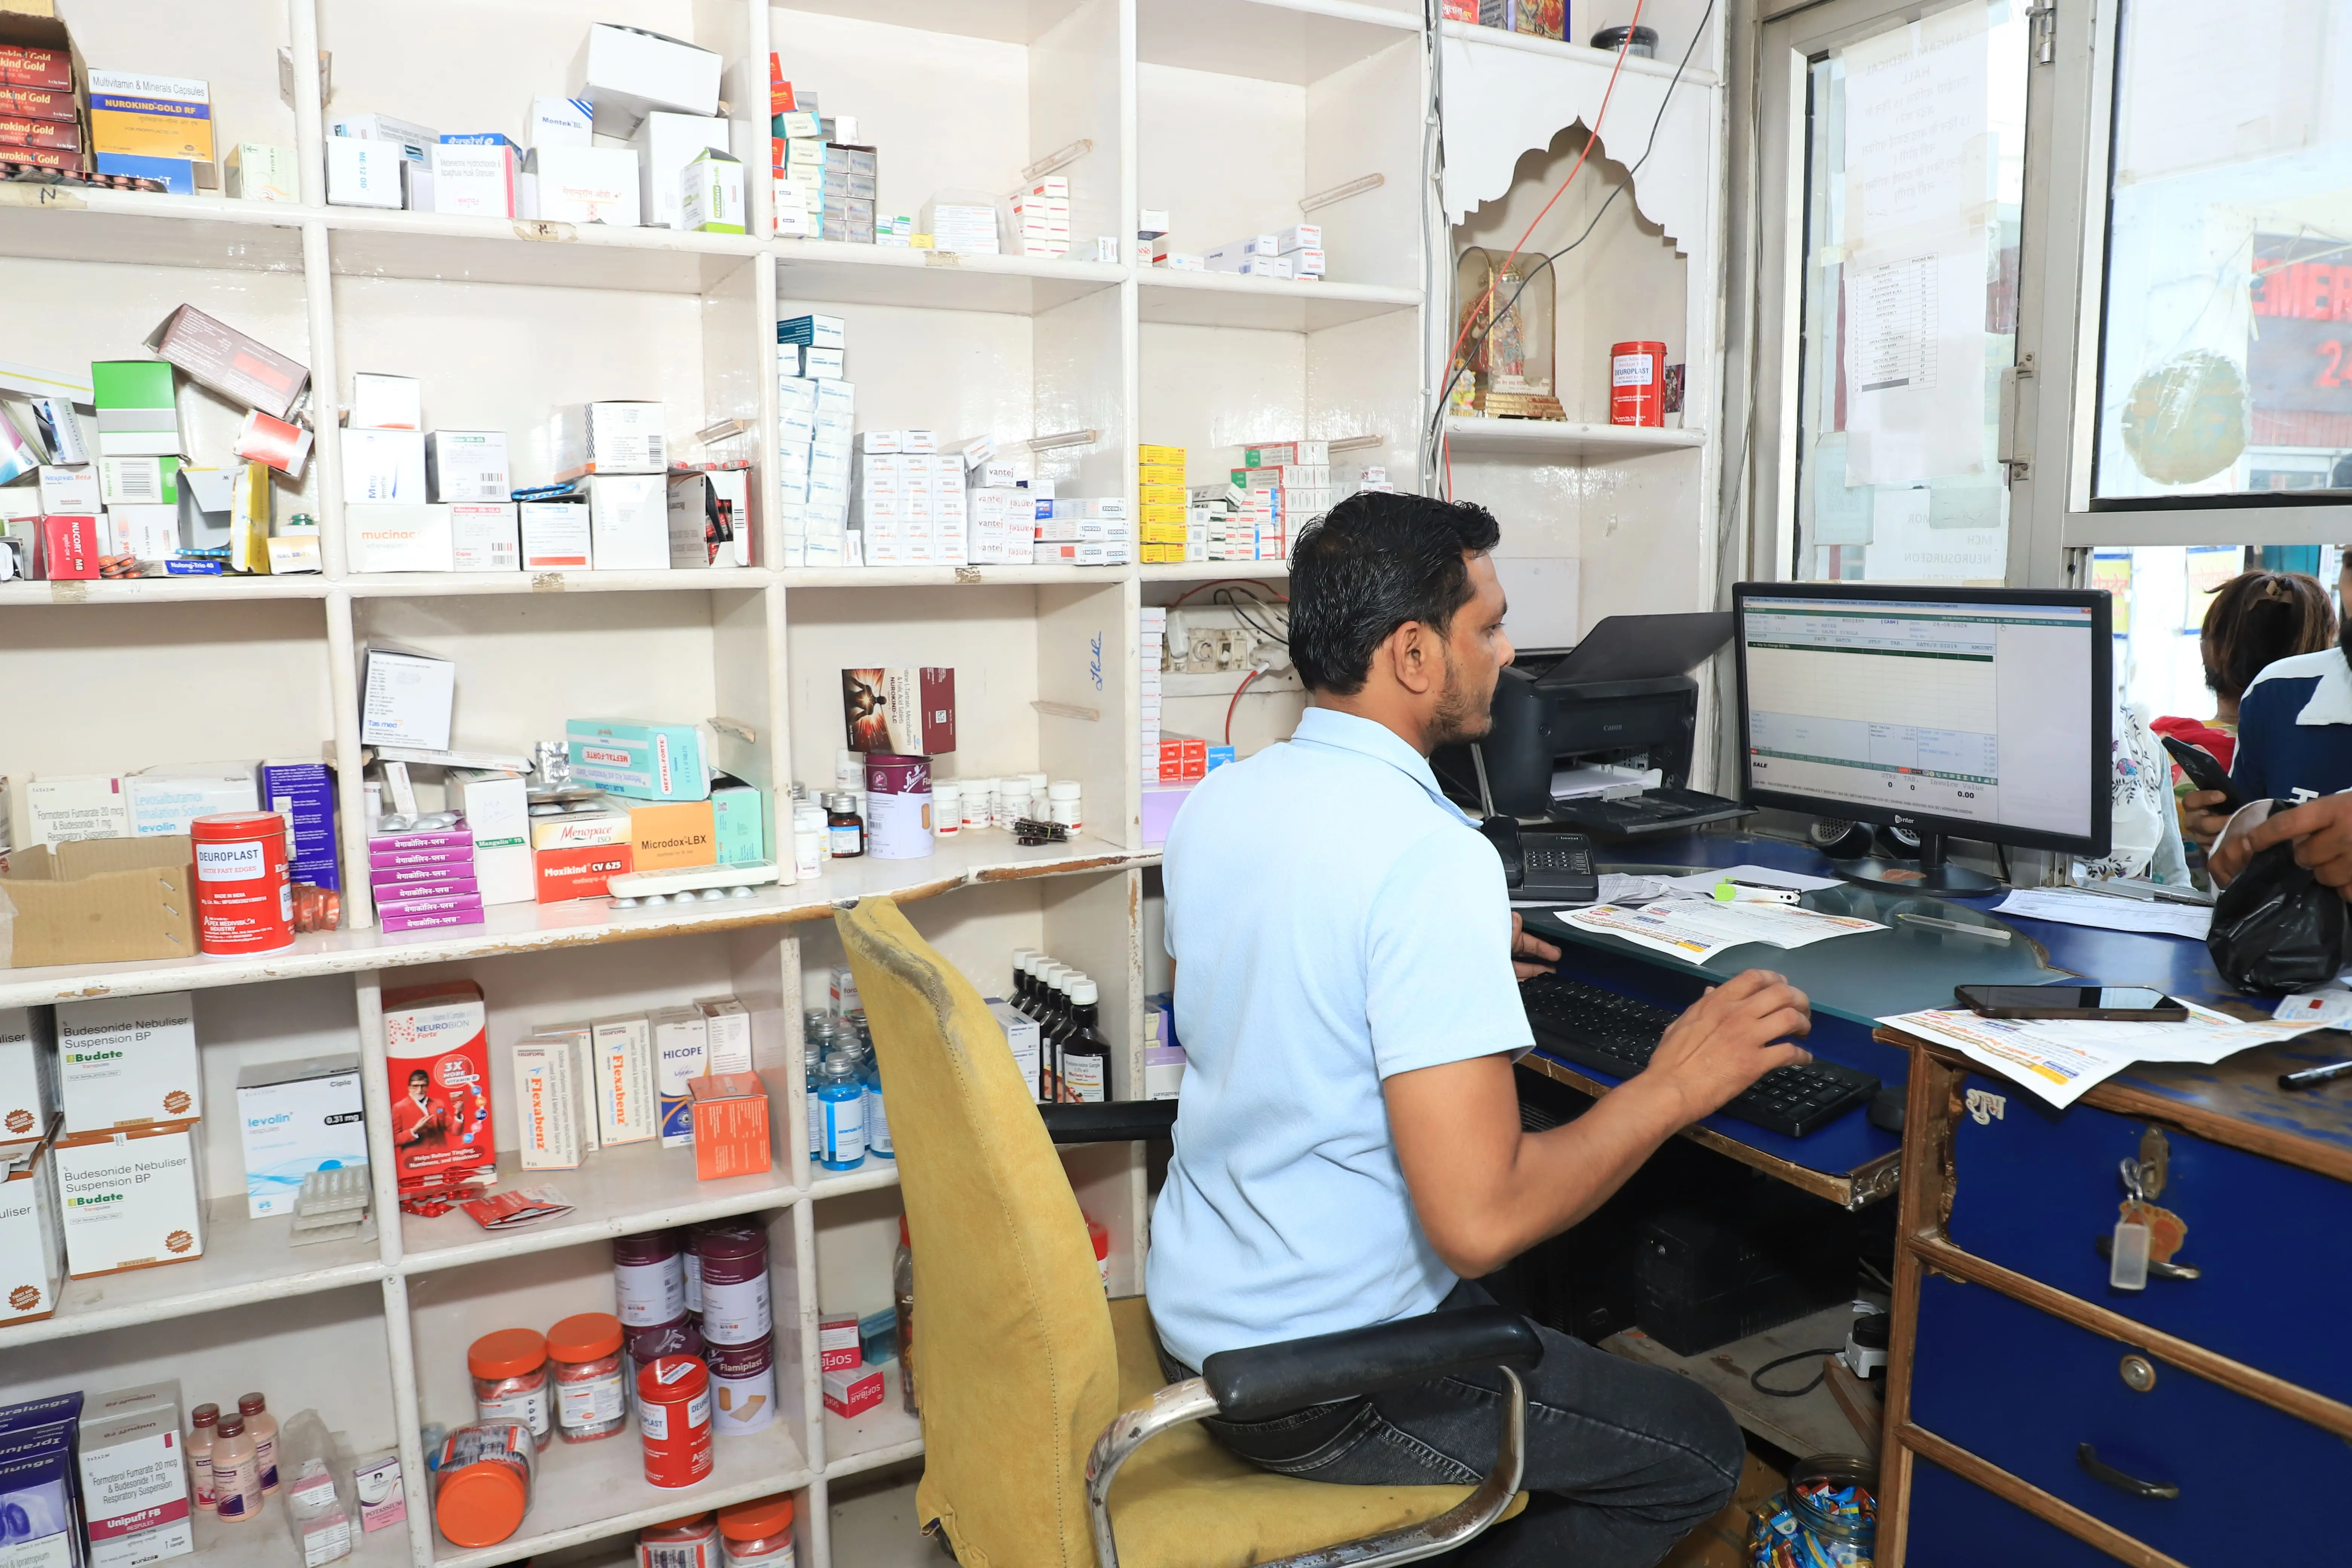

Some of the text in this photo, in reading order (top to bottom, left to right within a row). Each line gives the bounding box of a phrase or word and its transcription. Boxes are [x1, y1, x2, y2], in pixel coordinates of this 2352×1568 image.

[23, 60, 46, 72] Gold
[93, 77, 204, 96] Multivitamin & Minerals Capsules
[29, 93, 51, 104] Gold
[542, 116, 571, 127] Montek
[32, 124, 54, 135] Gold
[38, 154, 59, 165] Gold
[1615, 368, 1649, 376] DEUROPLAST
[989, 468, 1014, 479] vantej
[978, 495, 1003, 504] vantej
[1010, 500, 1035, 509] vantej
[978, 519, 1003, 528] vantej
[1009, 524, 1034, 534] vantej
[71, 522, 83, 571] NUCORT M8
[1008, 548, 1033, 558] vantej
[381, 720, 398, 728] med
[586, 750, 628, 763] MEFTAL-FORTE
[659, 739, 670, 792] MEFTAL-FORTE
[1930, 779, 1958, 788] Invoice
[1962, 782, 1984, 792] Value
[134, 792, 204, 806] Levosalbutamol
[1957, 791, 1975, 799] 0.00
[38, 807, 124, 820] Formoterol Fumarate 20 mcg
[136, 805, 217, 819] Inhalation Solution
[52, 821, 57, 830] &
[59, 819, 95, 830] Budesonide
[138, 822, 177, 833] levolin
[560, 825, 612, 841] Menopace
[478, 839, 508, 847] Maxgalin
[641, 835, 707, 850] Microdox-LBX
[199, 849, 259, 862] DEUROPLAST
[544, 864, 587, 877] Moxikind
[605, 861, 622, 870] 625
[64, 1017, 188, 1037] Budesonide Nebuliser
[416, 1020, 469, 1032] NEUROBION
[65, 1031, 152, 1049] Suspension BP
[75, 1050, 123, 1062] Budate
[663, 1046, 703, 1060] HICOPE
[444, 1061, 464, 1072] 3X
[612, 1054, 627, 1124] Flexabenz
[1965, 1088, 2007, 1125] शुभ
[531, 1077, 545, 1150] Flexabenz
[248, 1113, 360, 1128] levolin 0.31 mg
[64, 1158, 187, 1181] Budesonide Nebuliser
[410, 1159, 441, 1168] Numbness,
[66, 1173, 151, 1193] Suspension BP
[77, 1193, 124, 1206] Budate
[12, 1291, 25, 1300] TWIST
[720, 1358, 764, 1372] Flamiplast
[851, 1383, 881, 1403] SOFIBAR
[93, 1459, 178, 1486] Formoterol Fumarate 20 mcg
[108, 1472, 166, 1493] & Budesonide 1 mg
[103, 1480, 173, 1505] Respiratory Suspension
[365, 1500, 403, 1518] POTASSIUM
[107, 1507, 161, 1529] Unipuff FB
[126, 1519, 154, 1532] RESPULES
